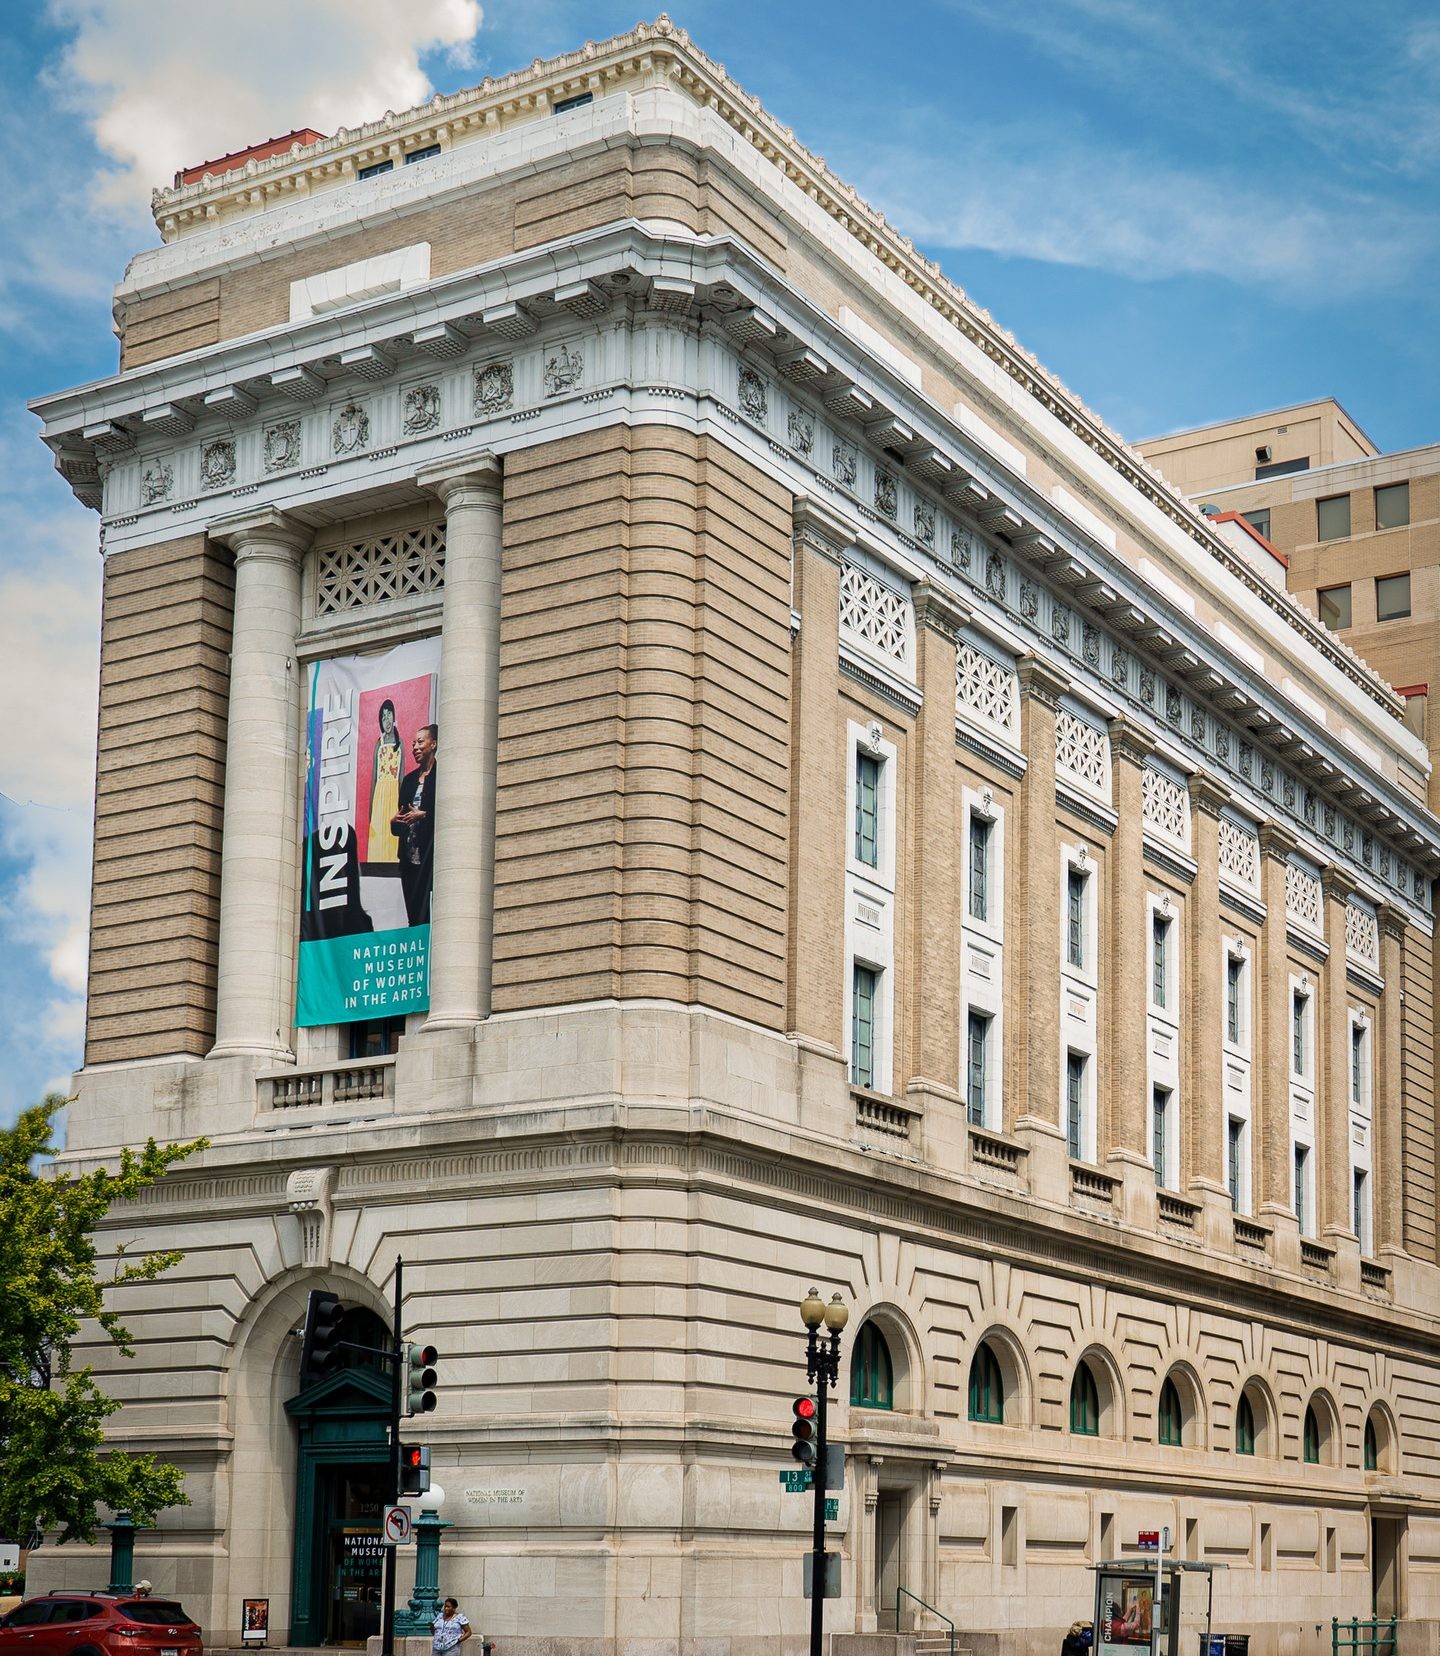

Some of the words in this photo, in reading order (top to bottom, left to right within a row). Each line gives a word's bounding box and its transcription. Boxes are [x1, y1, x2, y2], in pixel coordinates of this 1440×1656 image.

[318, 688, 353, 911] INSPIRE
[353, 939, 425, 960] NATIONAL
[365, 955, 424, 974] MUSEUM
[353, 979, 370, 992] OF
[376, 971, 424, 989] WOMEN
[345, 996, 357, 1009] IN
[362, 992, 387, 1007] THE
[392, 986, 422, 1003] ARTS
[787, 1471, 798, 1482] 13
[788, 1484, 803, 1492] 800
[360, 1503, 379, 1513] 1250
[344, 1536, 383, 1546] NATIONA
[351, 1547, 387, 1556] MUSEU
[344, 1557, 355, 1566] OF
[358, 1557, 383, 1566] WOME
[350, 1568, 365, 1577] THE
[1104, 1591, 1114, 1642] CHAMPION
